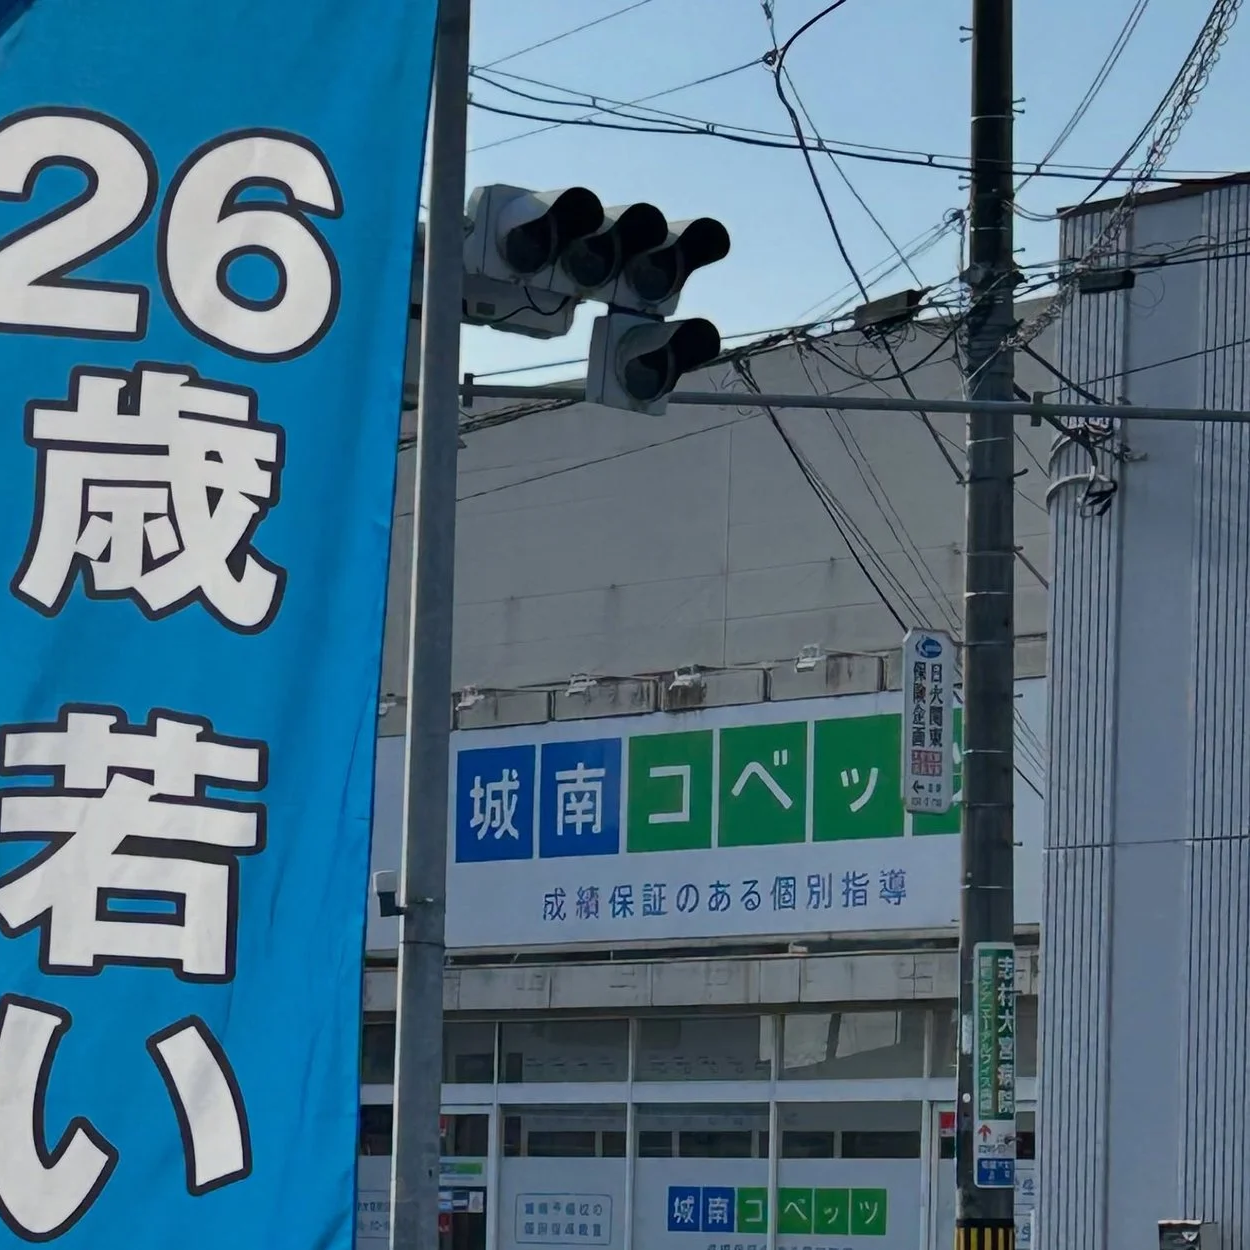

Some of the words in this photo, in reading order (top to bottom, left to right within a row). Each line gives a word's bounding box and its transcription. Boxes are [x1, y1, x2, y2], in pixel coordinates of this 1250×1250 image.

[469, 743, 962, 841] 城南コベッ
[542, 869, 907, 921] 成績保証のある個別指導
[673, 1195, 879, 1225] 城南コベッツ
